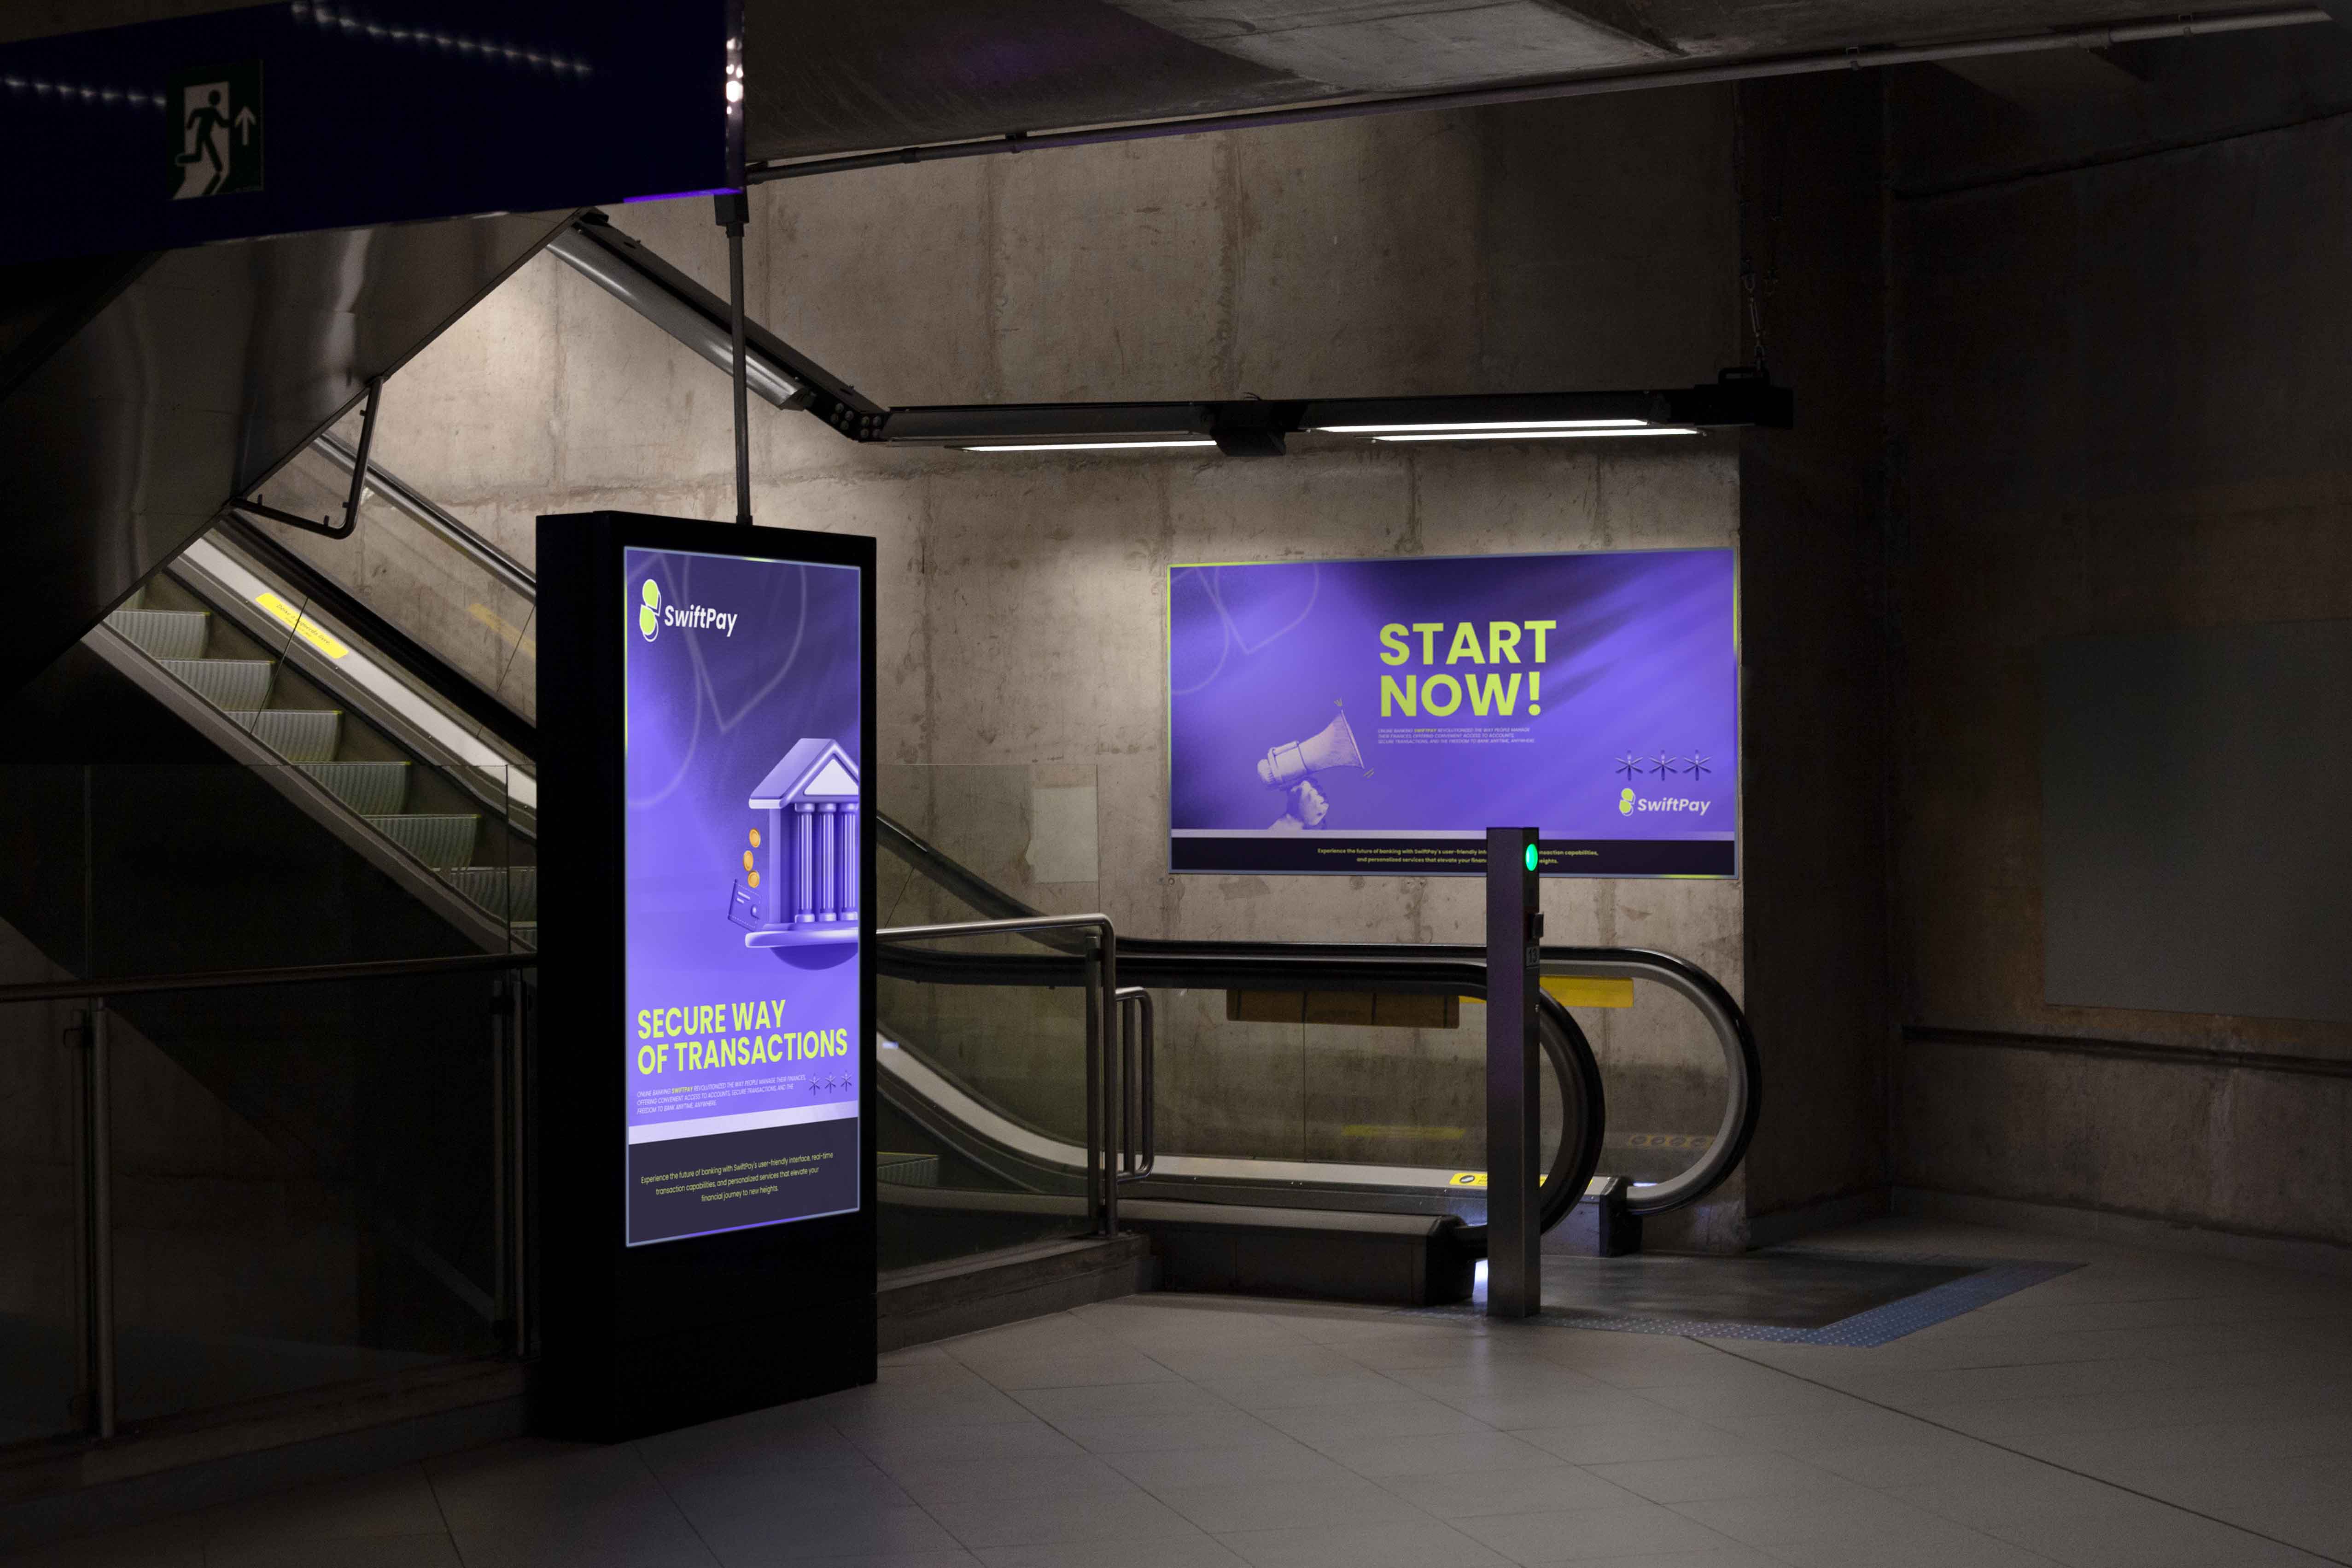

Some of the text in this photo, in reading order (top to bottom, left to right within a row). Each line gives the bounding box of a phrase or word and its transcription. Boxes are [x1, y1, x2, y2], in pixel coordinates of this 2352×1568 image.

[664, 604, 738, 637] SwiftPay
[1379, 620, 1557, 666] START
[1380, 671, 1541, 717] NOW!
[1637, 797, 1711, 816] SwiftPay
[637, 999, 786, 1040] SECURE WAY
[637, 1028, 848, 1075] OF TRANSACTIONS
[641, 1174, 669, 1185] Experience
[679, 1170, 695, 1179] future
[701, 1166, 722, 1176] banking
[734, 1161, 758, 1172] SwiftPay's
[758, 1157, 789, 1168] user-friendly
[789, 1154, 811, 1164] interface,
[811, 1151, 834, 1161] real-time
[656, 1166, 819, 1195] transaction capabilities, and personalized services that elevate your
[701, 1192, 723, 1202] financial
[723, 1190, 742, 1201] journey
[760, 1185, 779, 1195] heights.
